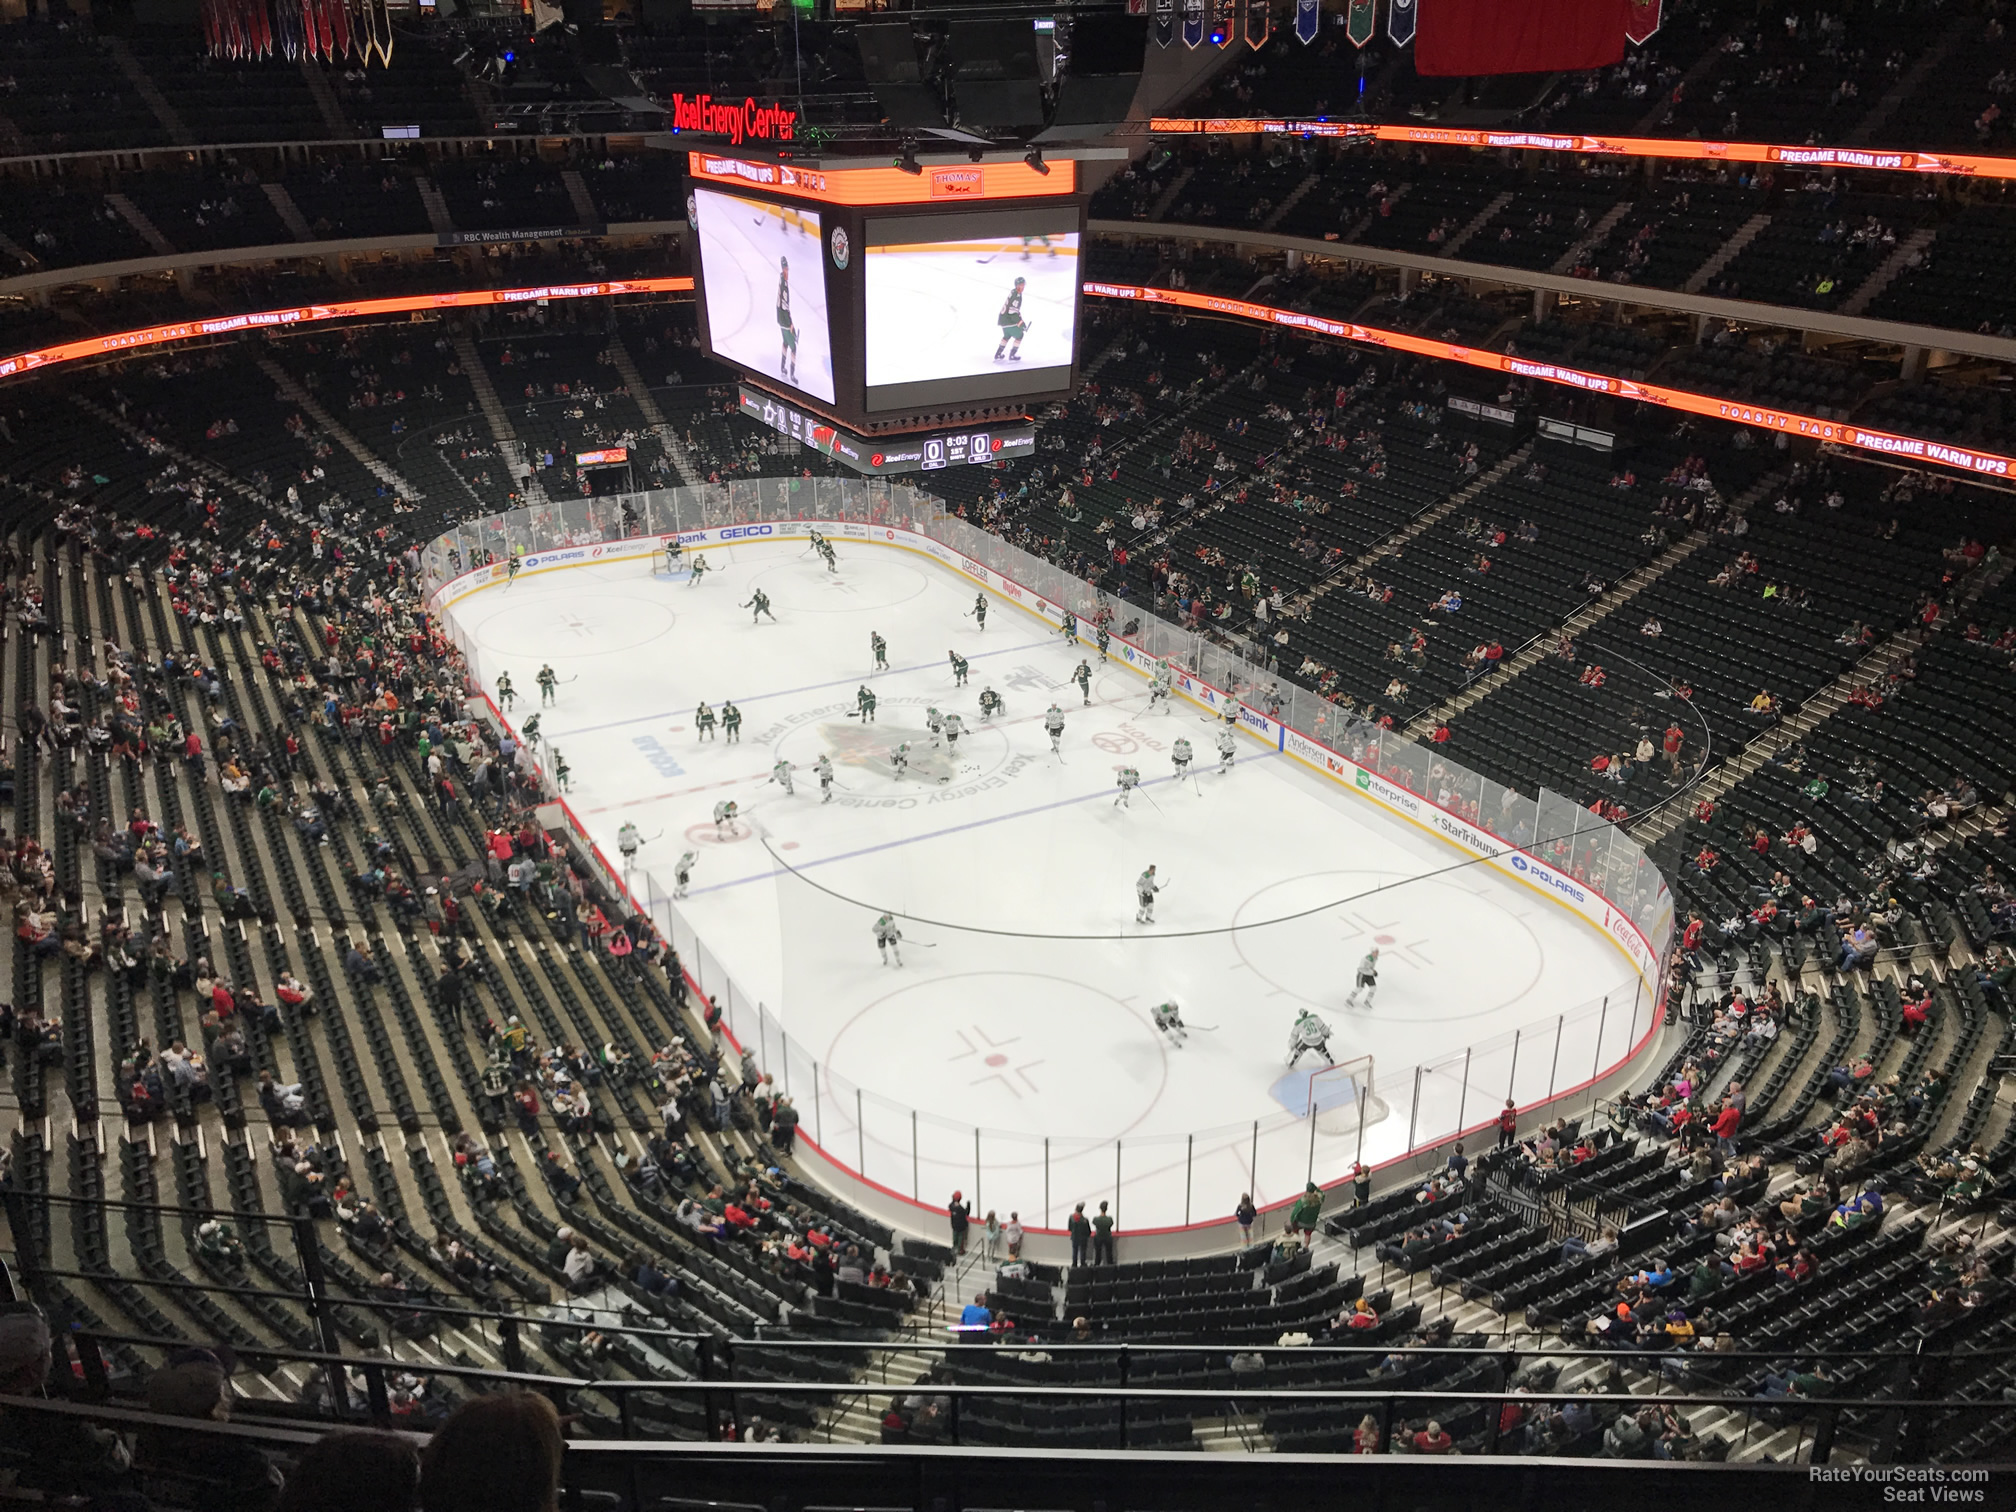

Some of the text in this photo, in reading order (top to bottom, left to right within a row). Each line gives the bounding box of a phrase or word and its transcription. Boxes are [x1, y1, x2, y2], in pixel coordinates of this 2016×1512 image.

[673, 93, 796, 145] Xcel Energy Center
[1409, 130, 1449, 141] TOASTY
[1488, 135, 1573, 149] PREGAME WARM UPS
[1780, 151, 1902, 168] PREGAME WARM UPS
[706, 159, 774, 183] PREGAME WARM UPS
[464, 232, 481, 242] RBC
[482, 230, 511, 241] Wealth
[512, 228, 563, 241] Management
[504, 286, 599, 301] PREGAME WARM UPS
[1093, 286, 1118, 297] WARM
[1120, 288, 1135, 298] UPS
[1208, 299, 1245, 313] TOASTY
[202, 311, 300, 333] PREGAME WARM UPS
[1275, 313, 1344, 335] PREGAME WARM UPS
[103, 332, 154, 349] TOASTY
[0, 361, 16, 375] UPS
[1511, 361, 1608, 390] PREGAME WARM UPS
[1720, 404, 1788, 428] TOASTY
[946, 436, 968, 447] 8:03
[974, 437, 986, 454] 0
[927, 443, 940, 460] 0
[951, 447, 963, 455] 1ST
[1856, 433, 2007, 475] PREGAME WARM UPS
[720, 525, 772, 540] GEICO
[541, 551, 585, 564] POLARIS
[962, 557, 988, 579] LOFFLER
[1137, 653, 1154, 671] TRI
[983, 697, 993, 705] 32
[752, 716, 788, 748] Xcel
[785, 699, 858, 724] Energy
[1243, 708, 1269, 733] bank
[1117, 722, 1168, 753] TOYOTA
[1288, 734, 1326, 763] Andersen
[837, 752, 1036, 810] Xcel Energy Center
[1531, 866, 1585, 903] POLARIS
